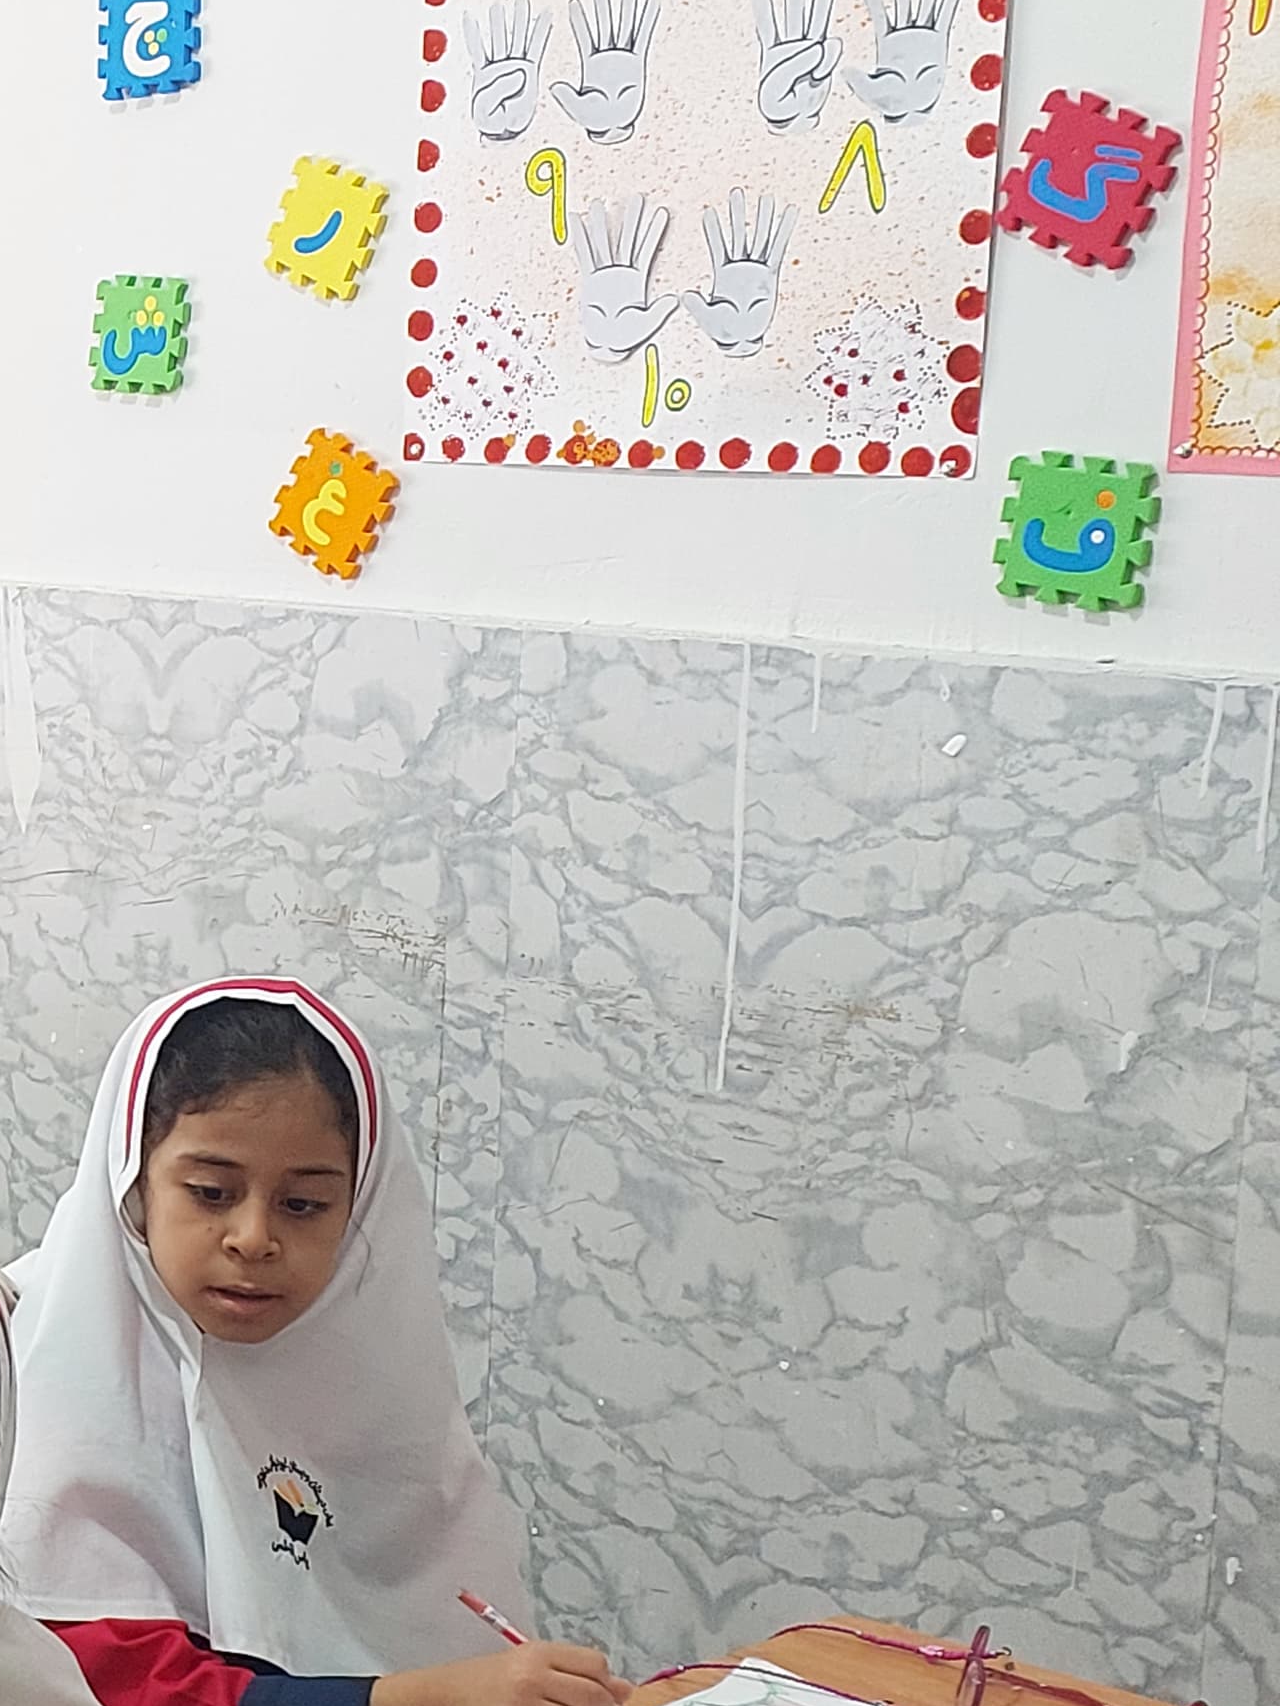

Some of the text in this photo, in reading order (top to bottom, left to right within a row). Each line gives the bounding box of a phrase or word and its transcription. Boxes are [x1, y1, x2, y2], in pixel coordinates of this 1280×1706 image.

[524, 147, 569, 246] ۹
[820, 120, 887, 213] ۸
[293, 209, 342, 254] ر
[102, 295, 167, 375] ش
[639, 344, 692, 428] ۱۰
[302, 461, 347, 546] غ
[1022, 489, 1115, 574] ف
